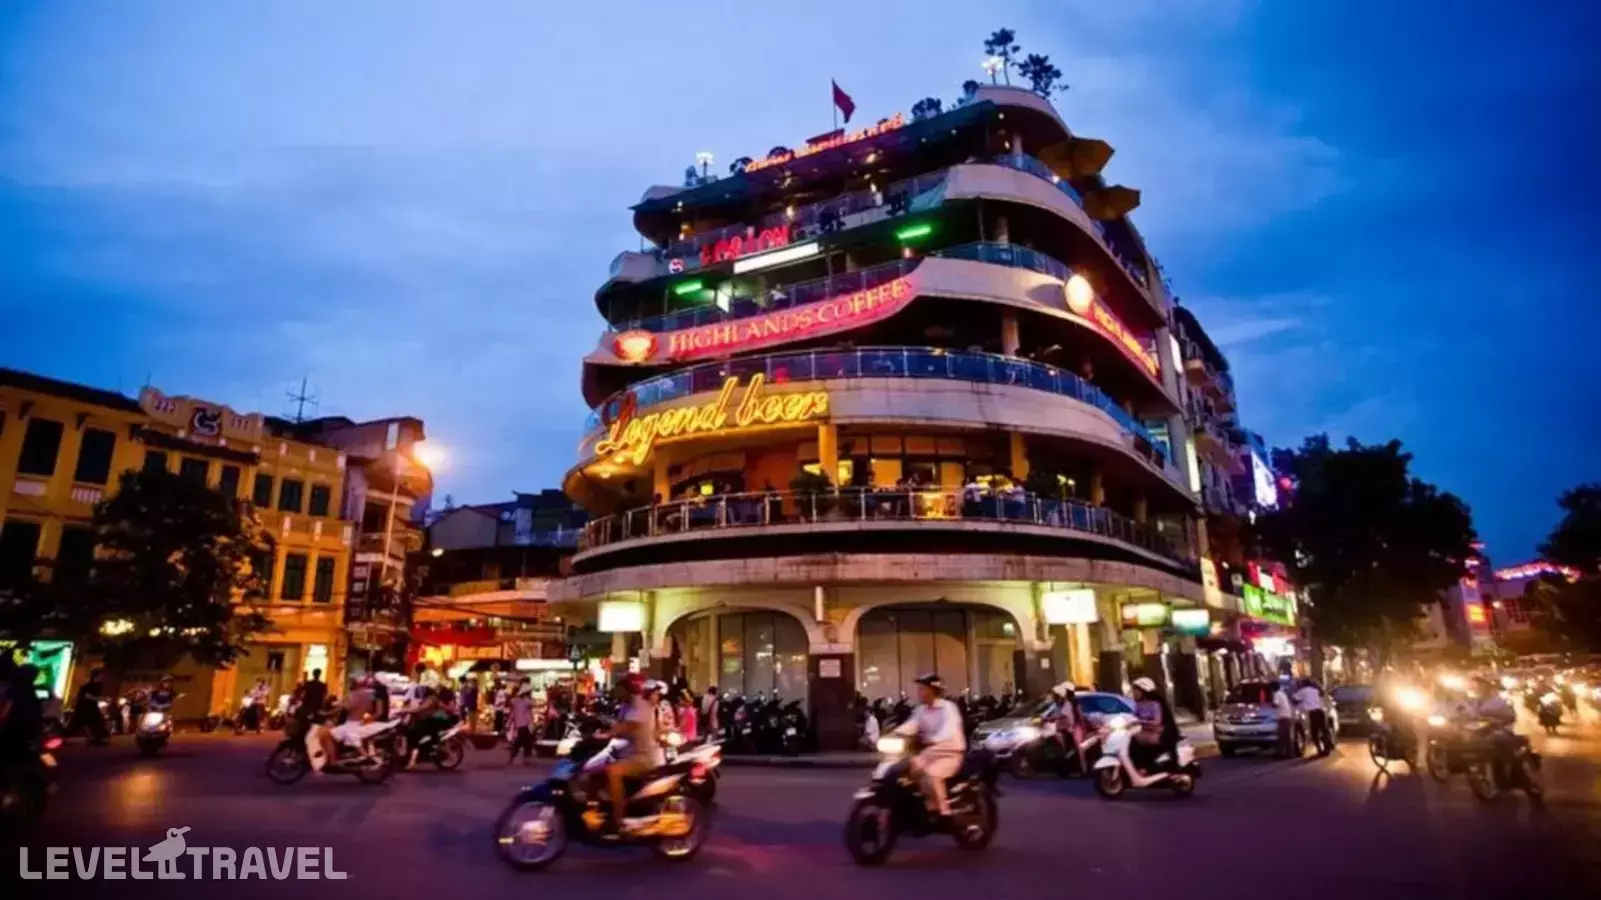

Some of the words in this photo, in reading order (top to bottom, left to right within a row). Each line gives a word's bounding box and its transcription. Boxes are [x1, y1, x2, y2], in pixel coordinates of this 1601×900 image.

[669, 310, 813, 353] HIGHLANDS
[817, 276, 909, 323] COFFEE
[594, 376, 738, 465] Legend
